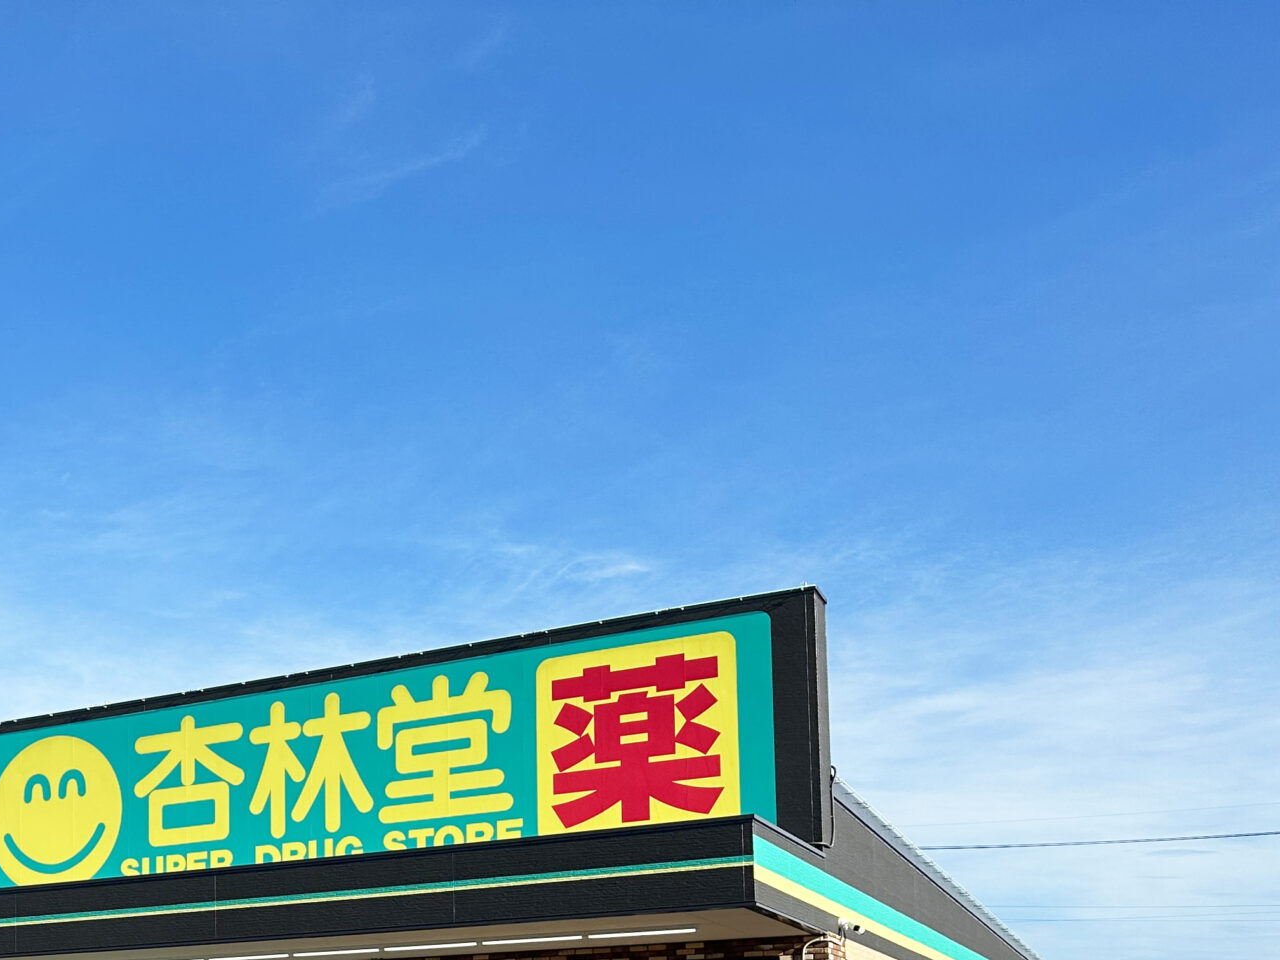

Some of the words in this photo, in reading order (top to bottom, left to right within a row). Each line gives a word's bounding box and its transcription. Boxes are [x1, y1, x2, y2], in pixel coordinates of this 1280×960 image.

[134, 671, 514, 848] 杏林堂
[551, 652, 724, 829] 薬
[121, 849, 233, 876] SUPER
[255, 836, 364, 864] DRUG
[383, 818, 523, 850] STORE
